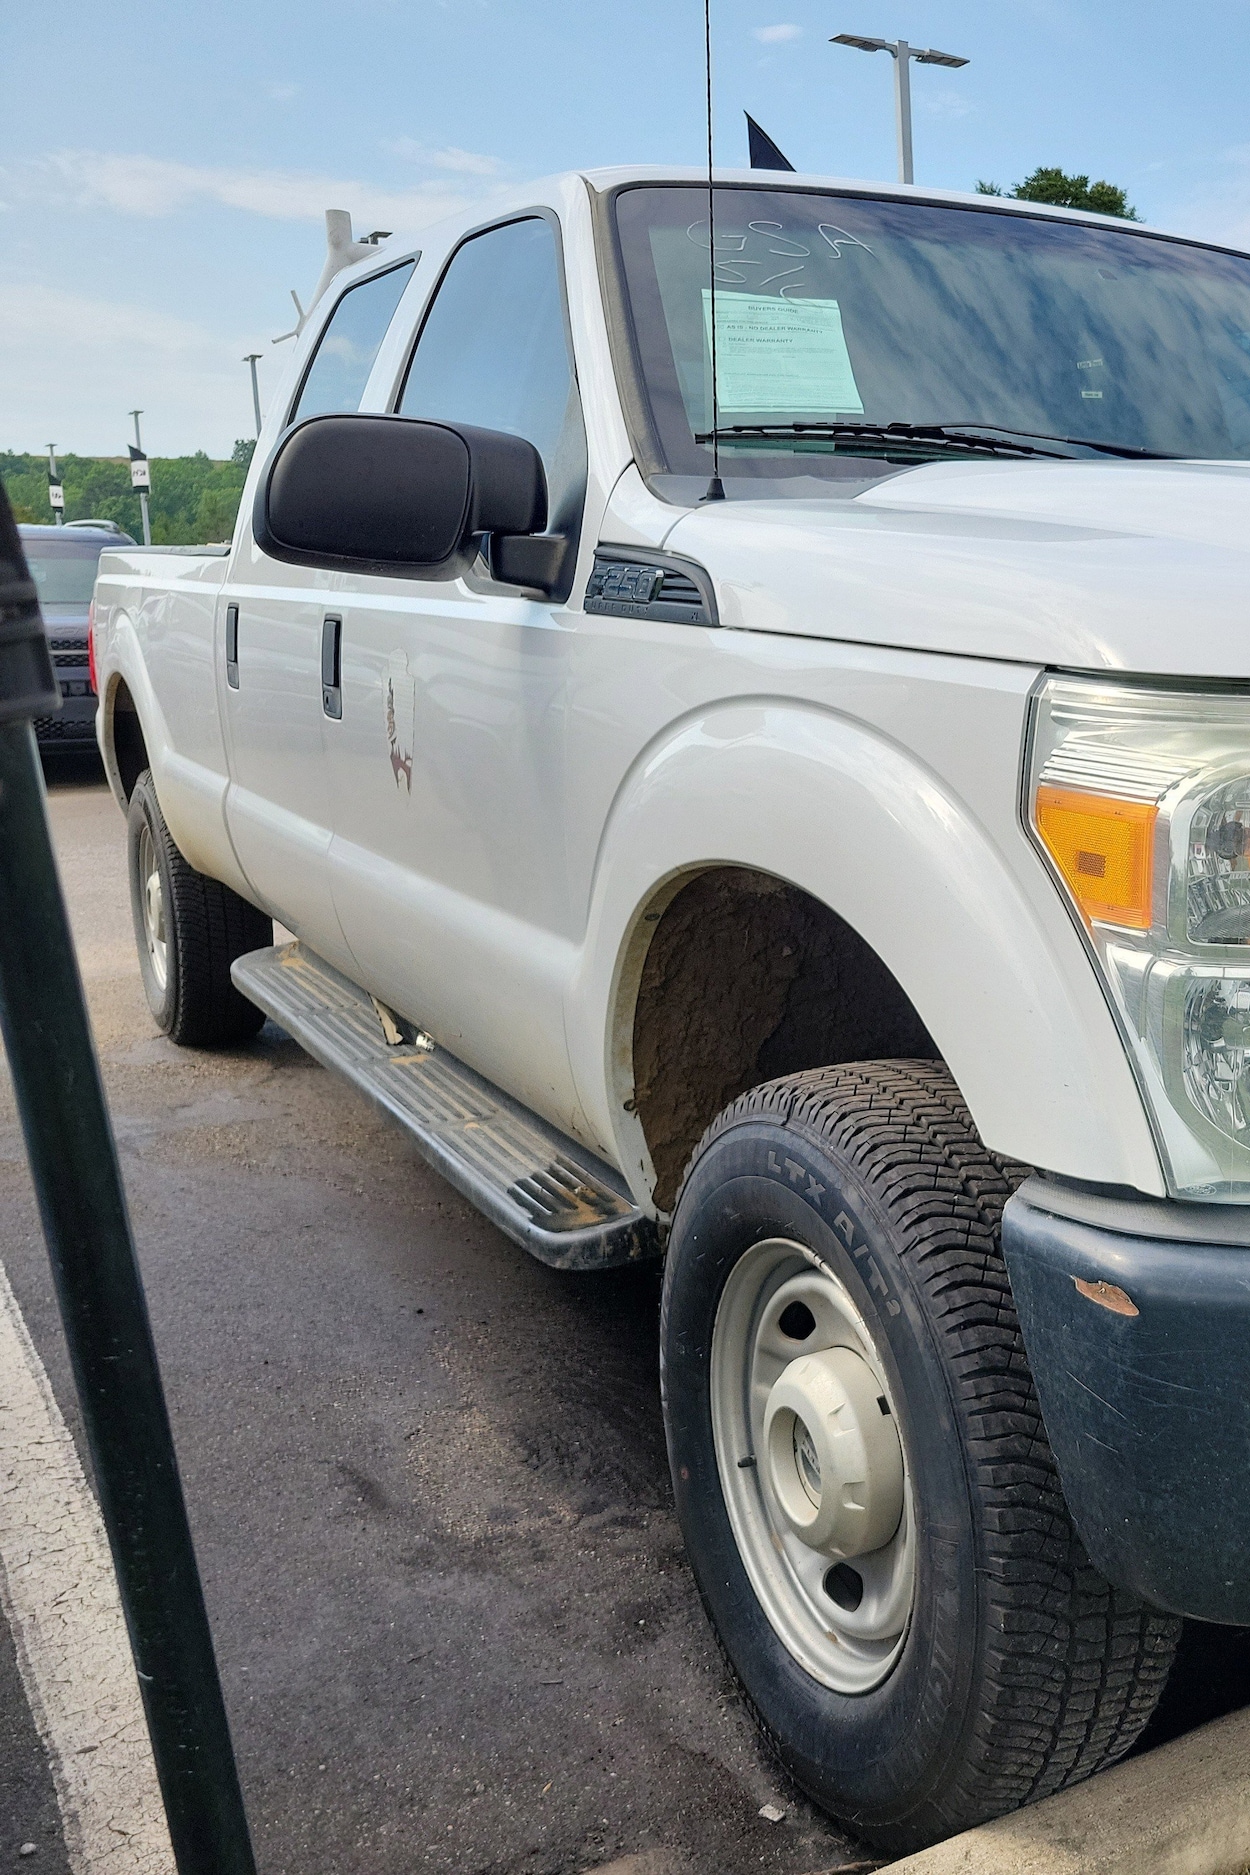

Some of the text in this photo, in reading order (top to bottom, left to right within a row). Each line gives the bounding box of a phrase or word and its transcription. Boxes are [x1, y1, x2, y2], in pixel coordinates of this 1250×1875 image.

[687, 220, 876, 259] GSA
[747, 305, 776, 313] BUYERS
[787, 325, 824, 334] WARRANTY
[620, 604, 650, 616] DUTY
[768, 1151, 826, 1208] LTX
